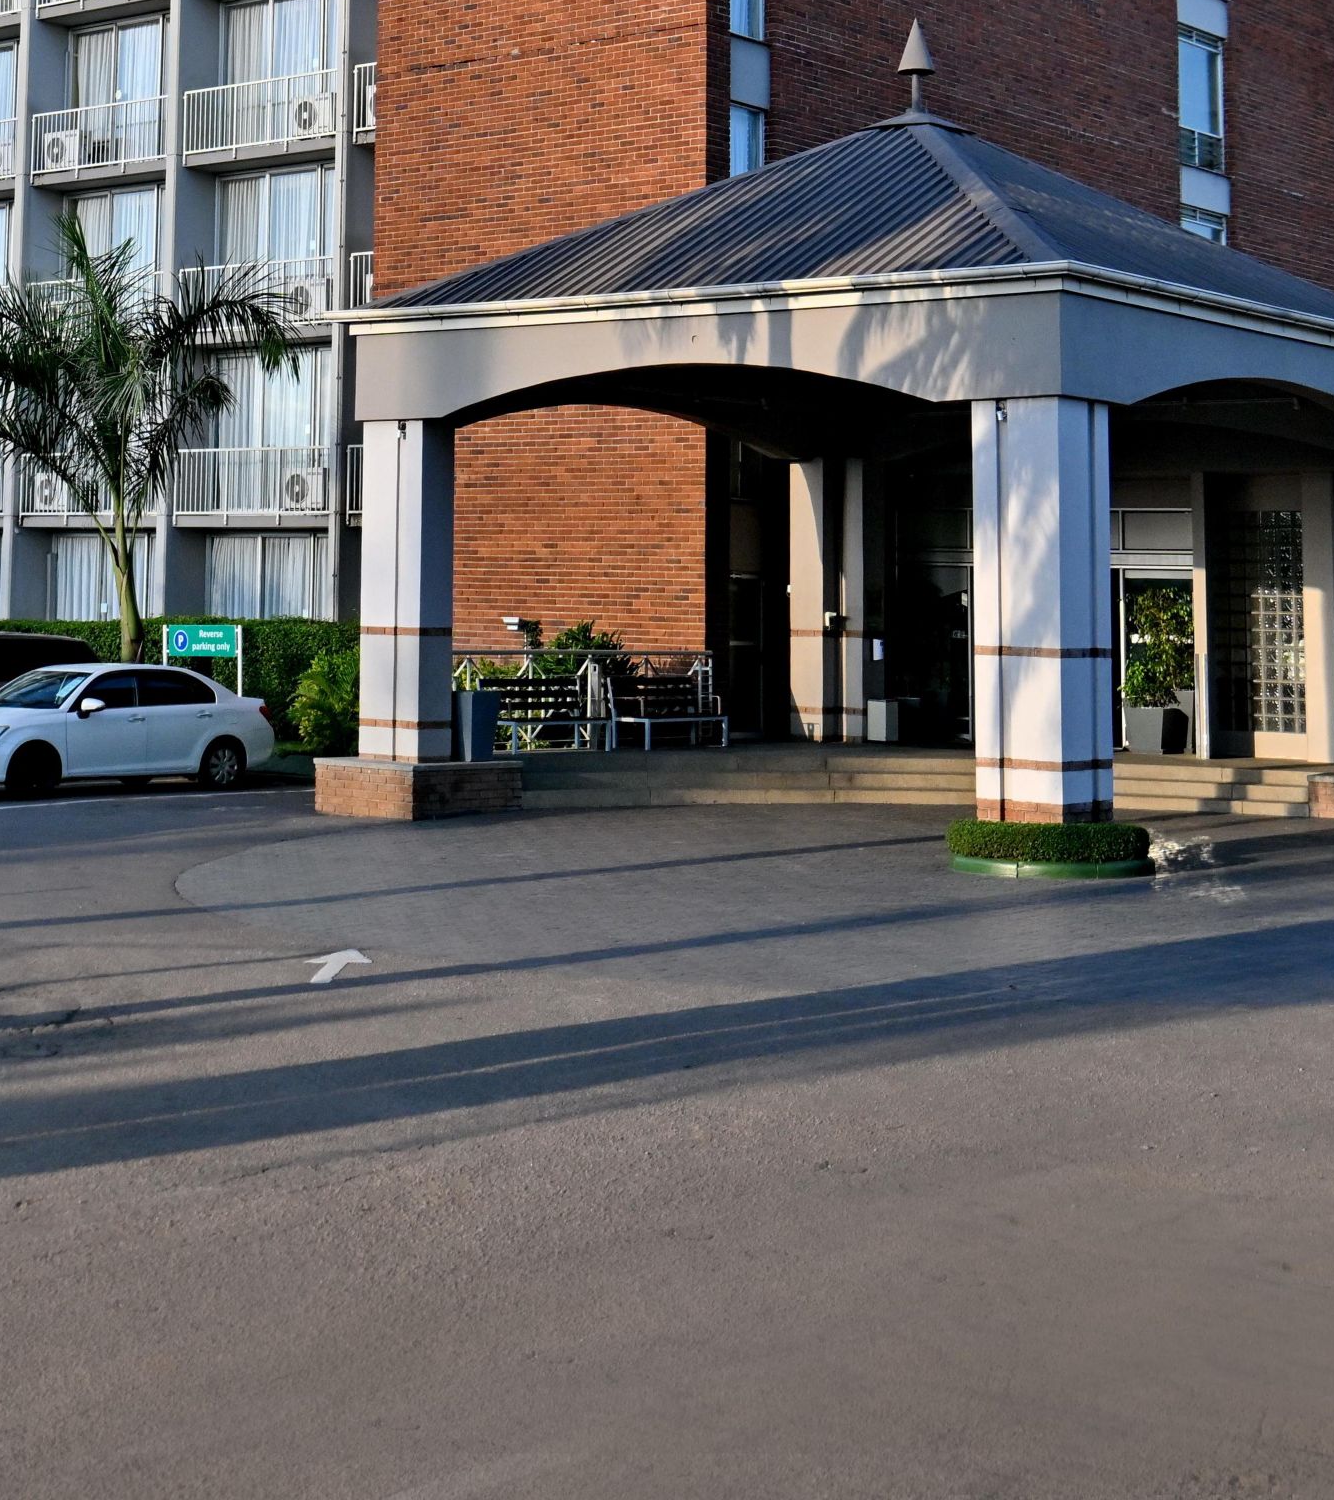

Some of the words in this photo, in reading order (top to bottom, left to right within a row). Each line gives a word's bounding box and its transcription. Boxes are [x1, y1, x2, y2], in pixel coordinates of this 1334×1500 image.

[198, 629, 224, 638] Reverse
[177, 634, 185, 647] P
[192, 642, 216, 652] parking
[216, 642, 230, 651] only
